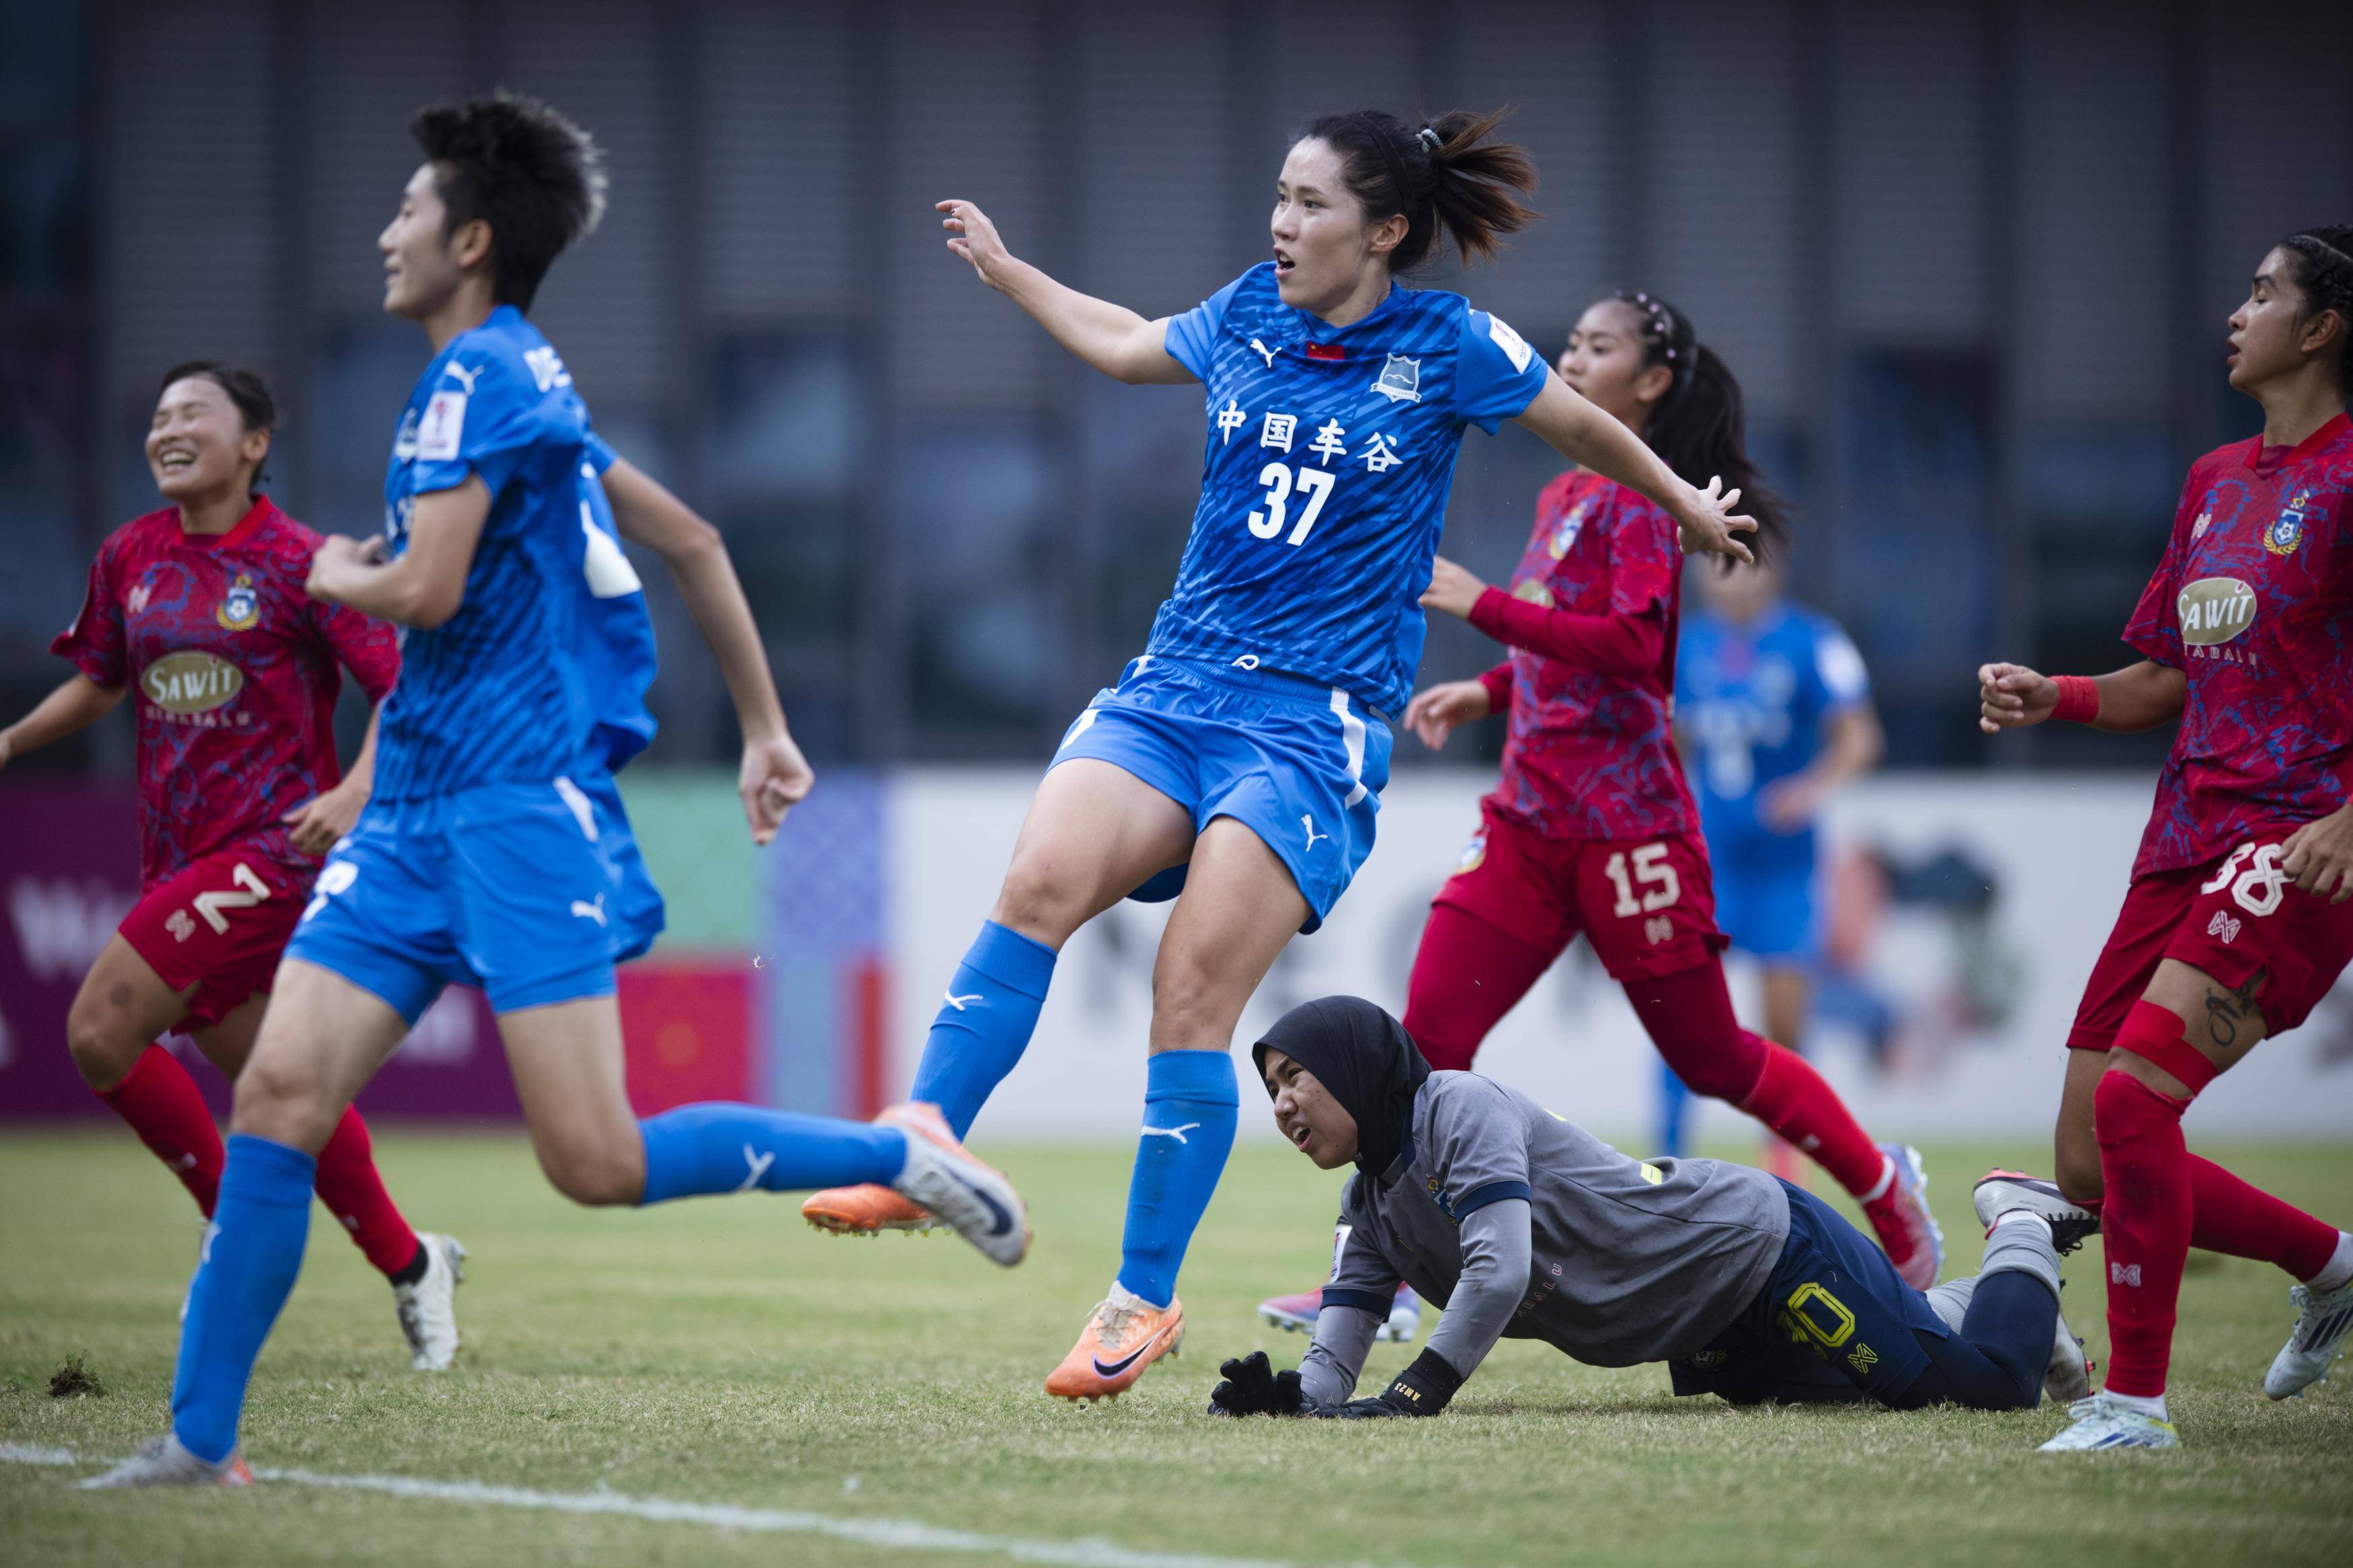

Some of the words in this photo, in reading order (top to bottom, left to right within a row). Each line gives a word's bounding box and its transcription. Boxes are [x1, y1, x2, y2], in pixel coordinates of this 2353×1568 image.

[1218, 399, 1403, 472] 中国车谷
[1248, 462, 1337, 546] 37
[192, 862, 271, 936] 2
[1605, 841, 1681, 918] 15
